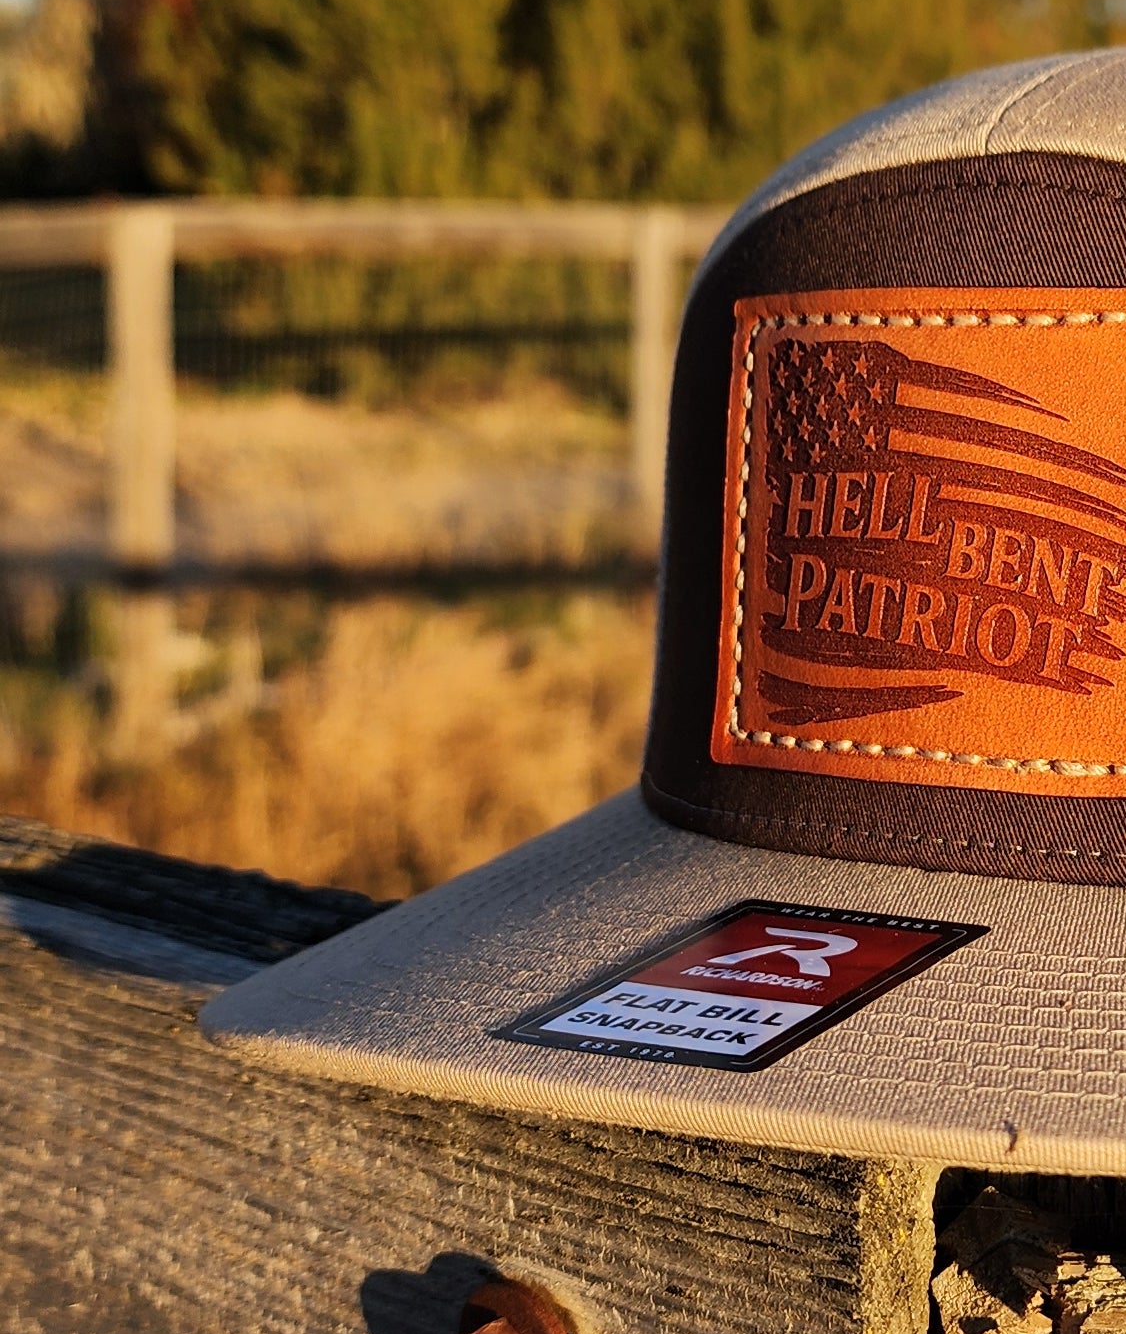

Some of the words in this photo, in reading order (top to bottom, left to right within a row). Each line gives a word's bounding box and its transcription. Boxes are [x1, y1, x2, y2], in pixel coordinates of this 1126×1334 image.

[785, 471, 944, 545] HELL
[944, 519, 1124, 618] BENT
[781, 553, 1085, 683] PATRIOT
[780, 907, 831, 918] WEAR
[840, 915, 879, 924] THE
[886, 920, 941, 931] BEST
[679, 965, 823, 991] RICHARDSON
[602, 992, 700, 1014] FLAT
[696, 1005, 784, 1027] BILL
[567, 1011, 759, 1045] SNAPBACK
[579, 1040, 621, 1052] EST
